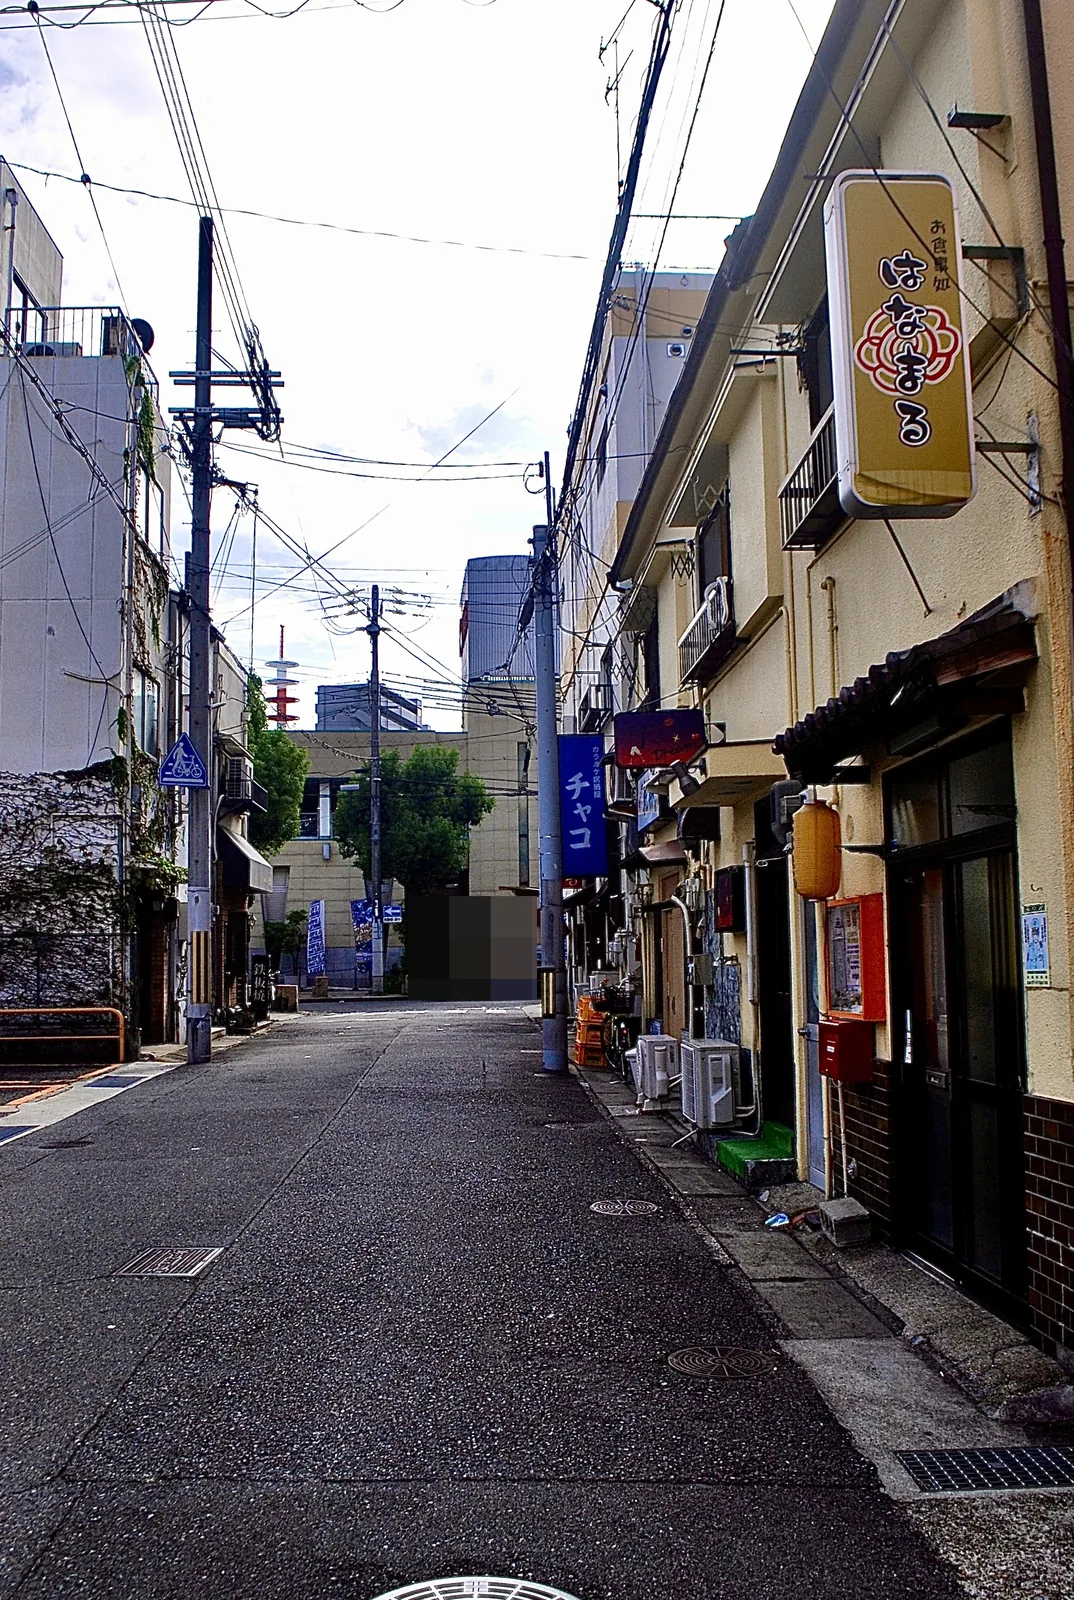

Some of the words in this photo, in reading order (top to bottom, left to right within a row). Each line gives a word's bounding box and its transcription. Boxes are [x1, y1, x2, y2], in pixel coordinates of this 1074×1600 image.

[930, 219, 951, 292] お食事処
[879, 250, 931, 447] はなまる
[592, 746, 601, 798] カラオケ居酒屋
[565, 772, 592, 849] チャコ
[254, 963, 266, 1002] 鉄板焼
